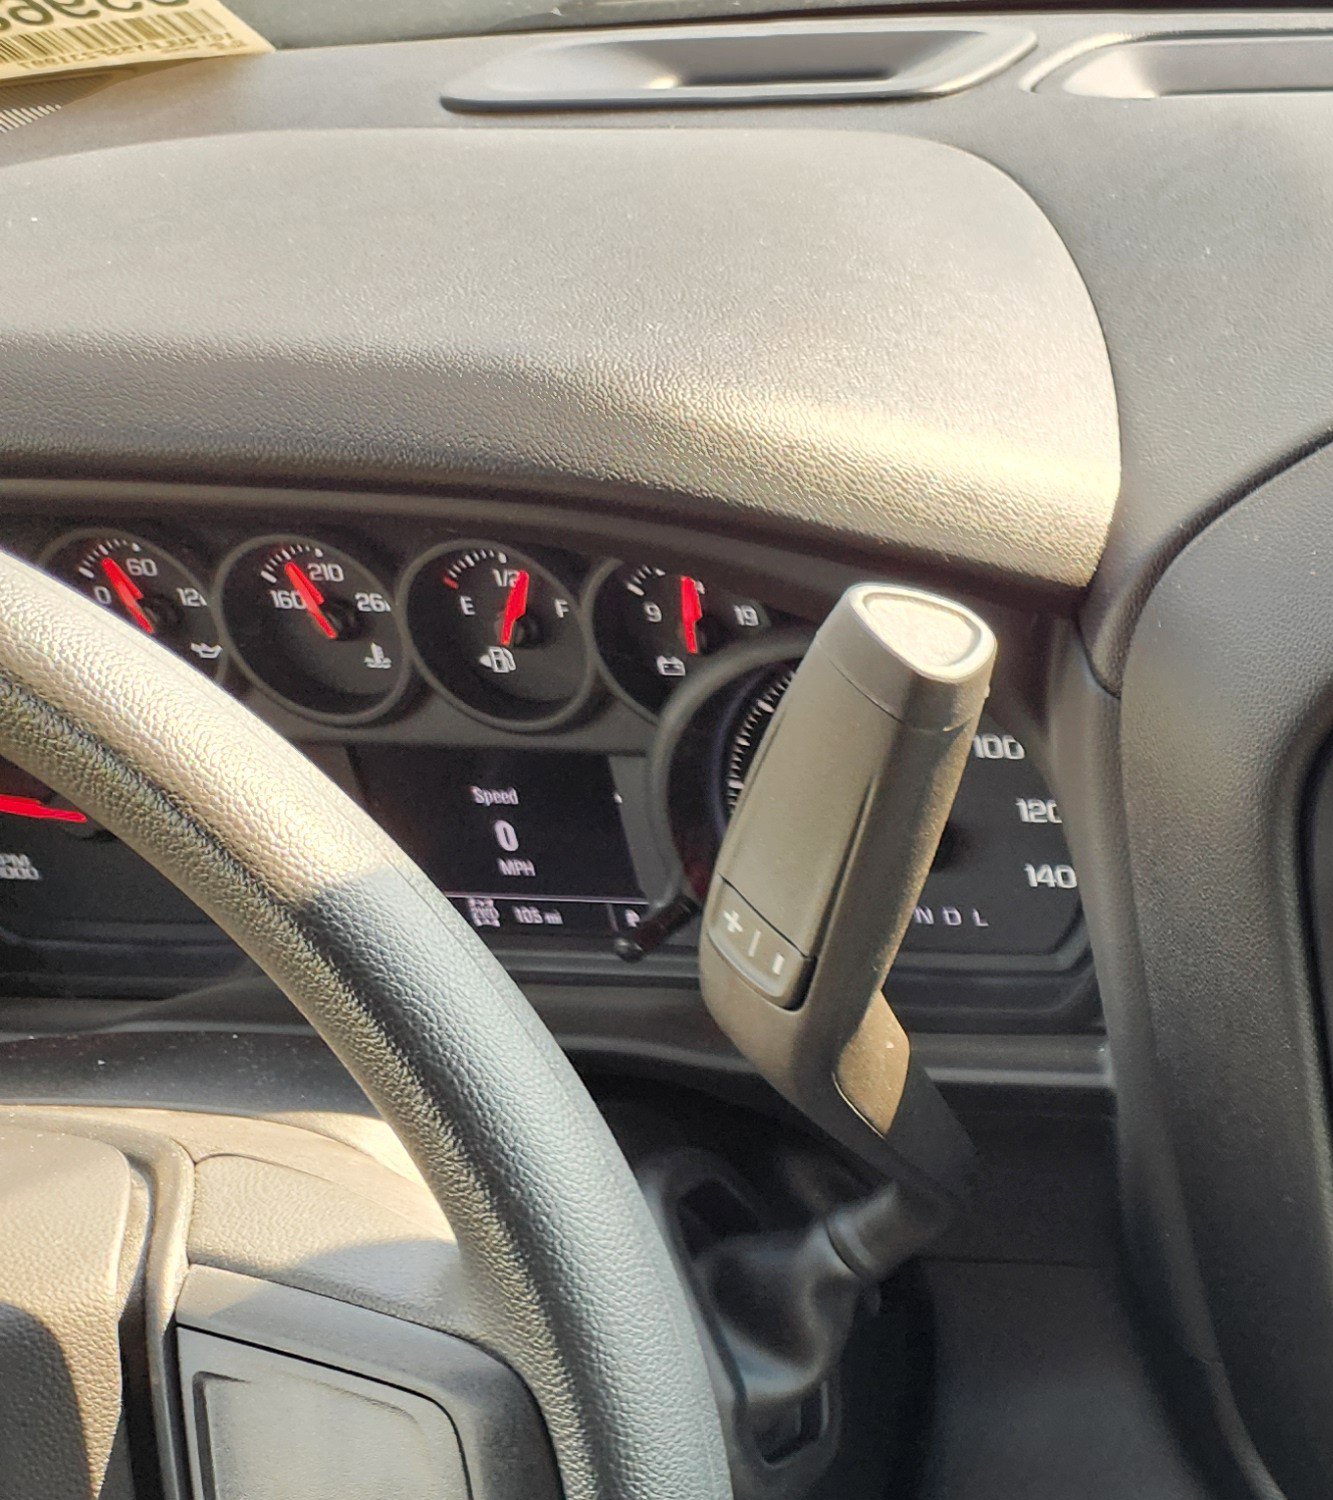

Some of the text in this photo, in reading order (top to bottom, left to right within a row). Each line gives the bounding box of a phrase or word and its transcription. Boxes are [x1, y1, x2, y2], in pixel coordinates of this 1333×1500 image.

[126, 558, 158, 577] 60
[306, 563, 345, 582] 210
[93, 585, 112, 605] 0
[354, 592, 391, 613] 26
[460, 595, 476, 616] E
[554, 598, 570, 618] F
[643, 601, 662, 623] 9
[733, 604, 759, 627] 19
[973, 734, 1026, 760] 100
[470, 785, 520, 807] Speed
[494, 819, 520, 852] 0
[497, 857, 537, 877] MPH
[1025, 863, 1079, 889] 140
[913, 905, 990, 927] N D L
